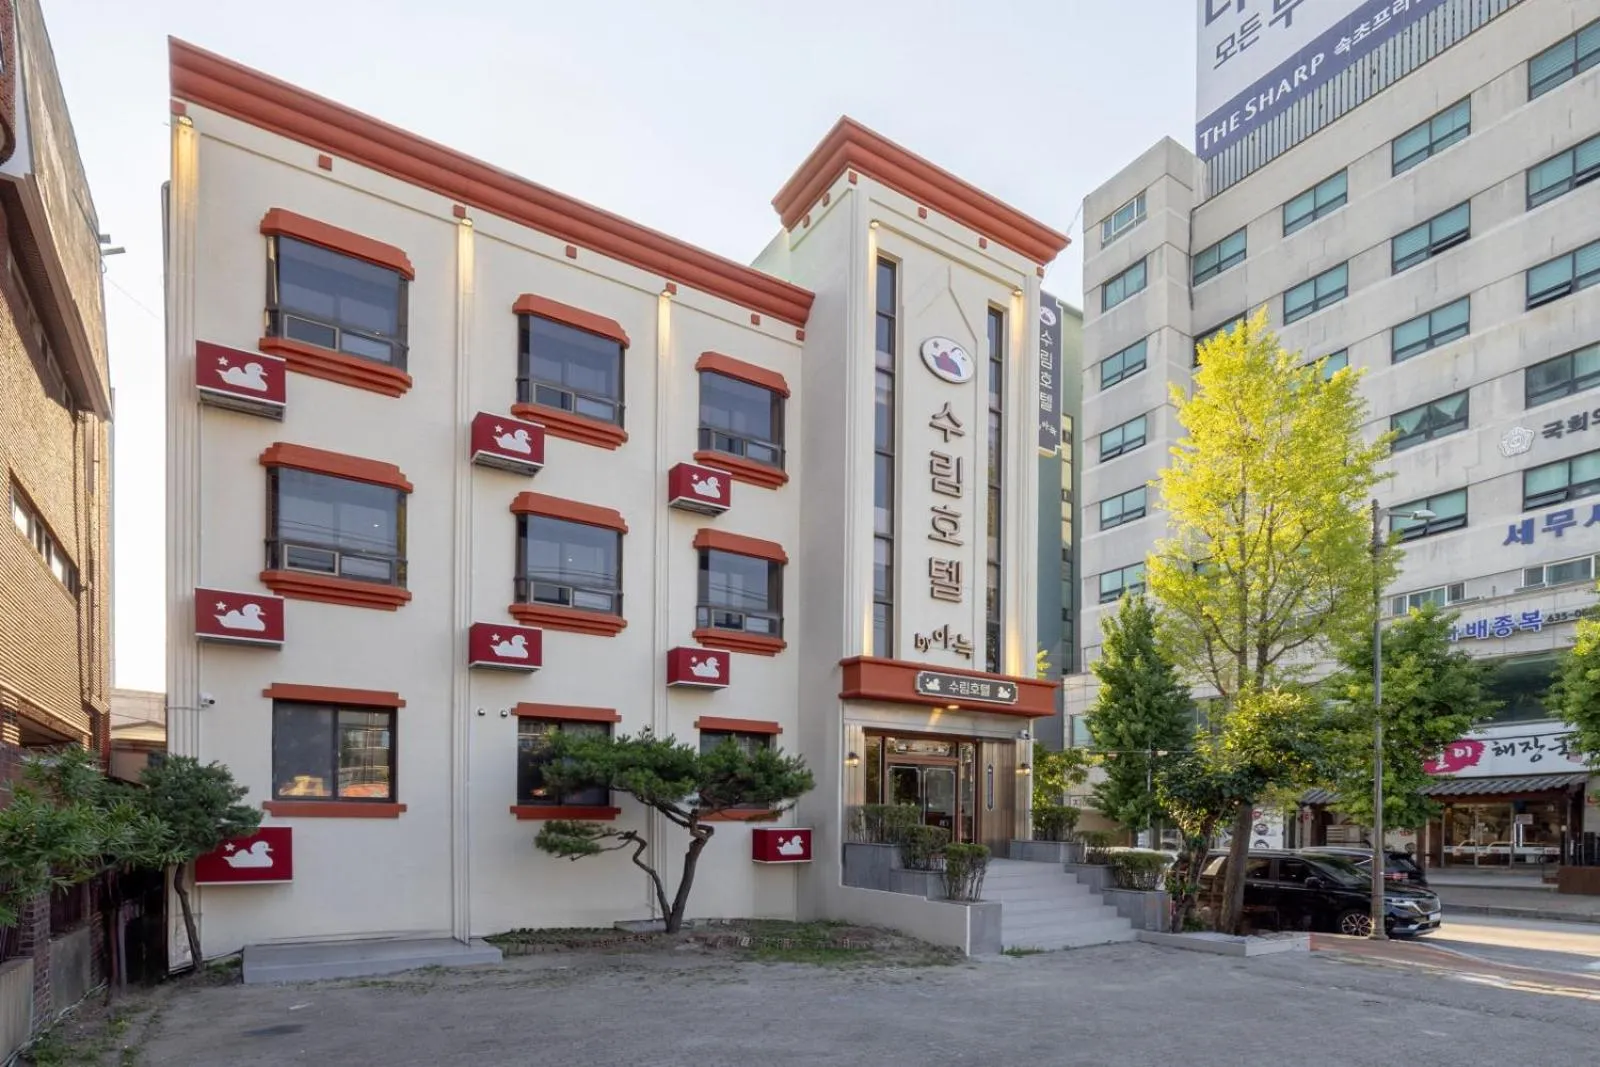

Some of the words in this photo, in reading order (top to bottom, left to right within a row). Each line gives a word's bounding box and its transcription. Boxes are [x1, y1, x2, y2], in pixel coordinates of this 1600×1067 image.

[1213, 12, 1262, 70] 모든
[1199, 110, 1241, 151] THE
[1244, 52, 1325, 121] SHARP
[928, 401, 965, 603] 수림호텔
[948, 680, 991, 697] 수림호텔
